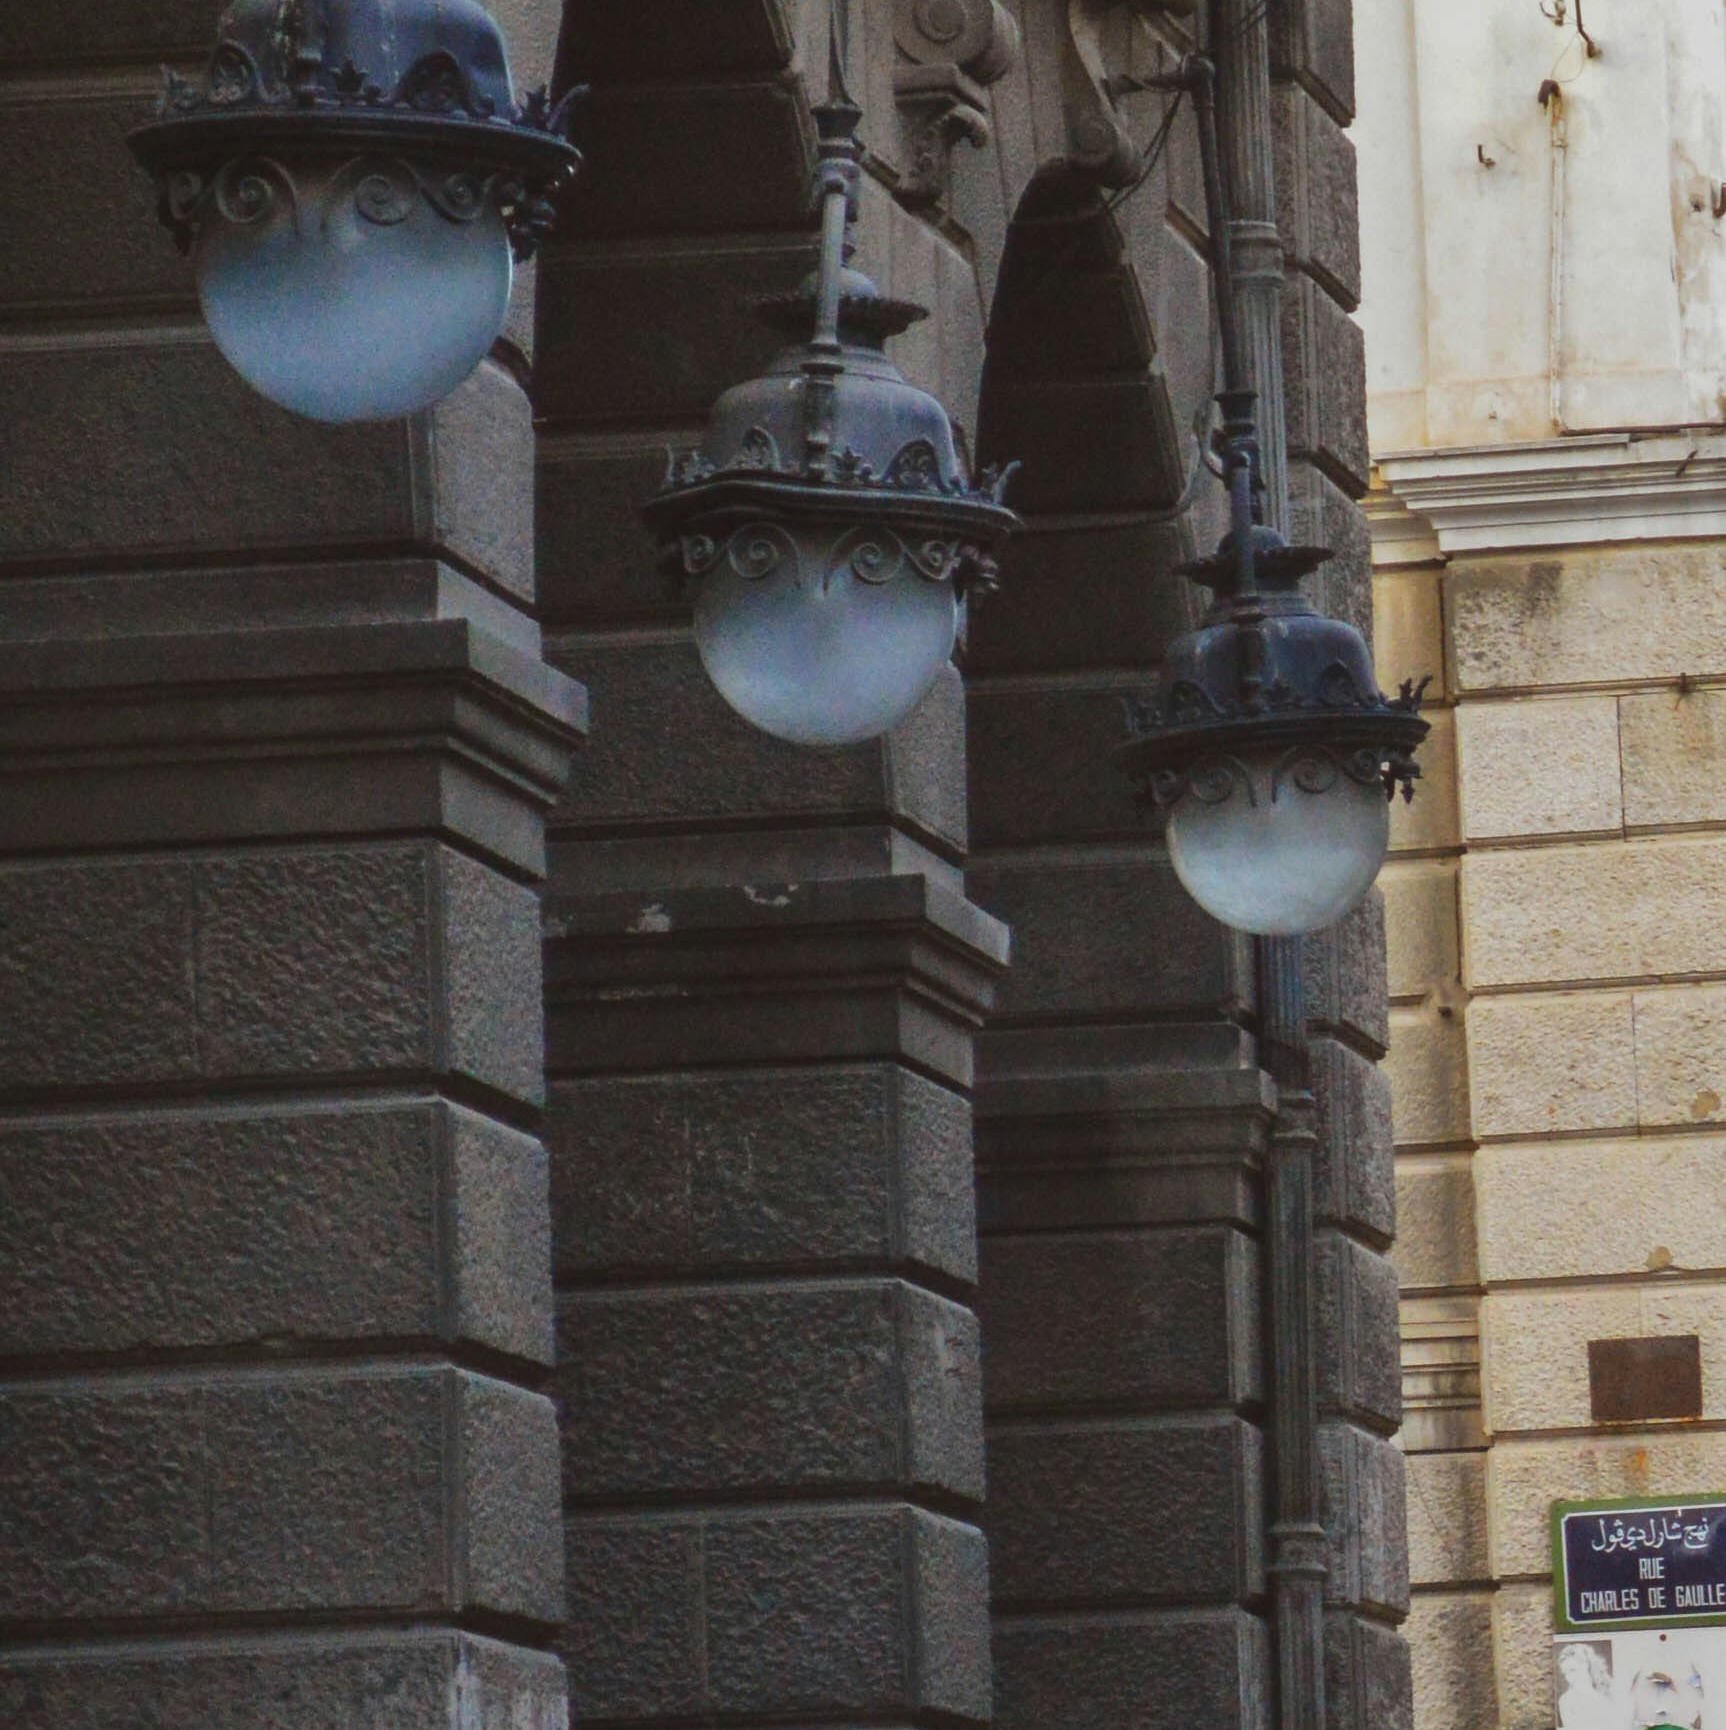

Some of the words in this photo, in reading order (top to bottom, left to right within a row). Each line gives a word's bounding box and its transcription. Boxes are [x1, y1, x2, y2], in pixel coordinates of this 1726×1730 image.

[1620, 1526, 1646, 1551] دي
[1643, 1517, 1682, 1549] شارل
[1683, 1517, 1710, 1549] نهج
[1639, 1557, 1665, 1580] RUE
[1580, 1588, 1640, 1614] CHARLES
[1649, 1587, 1667, 1608] DE
[1675, 1583, 1726, 1607] GAULLE
